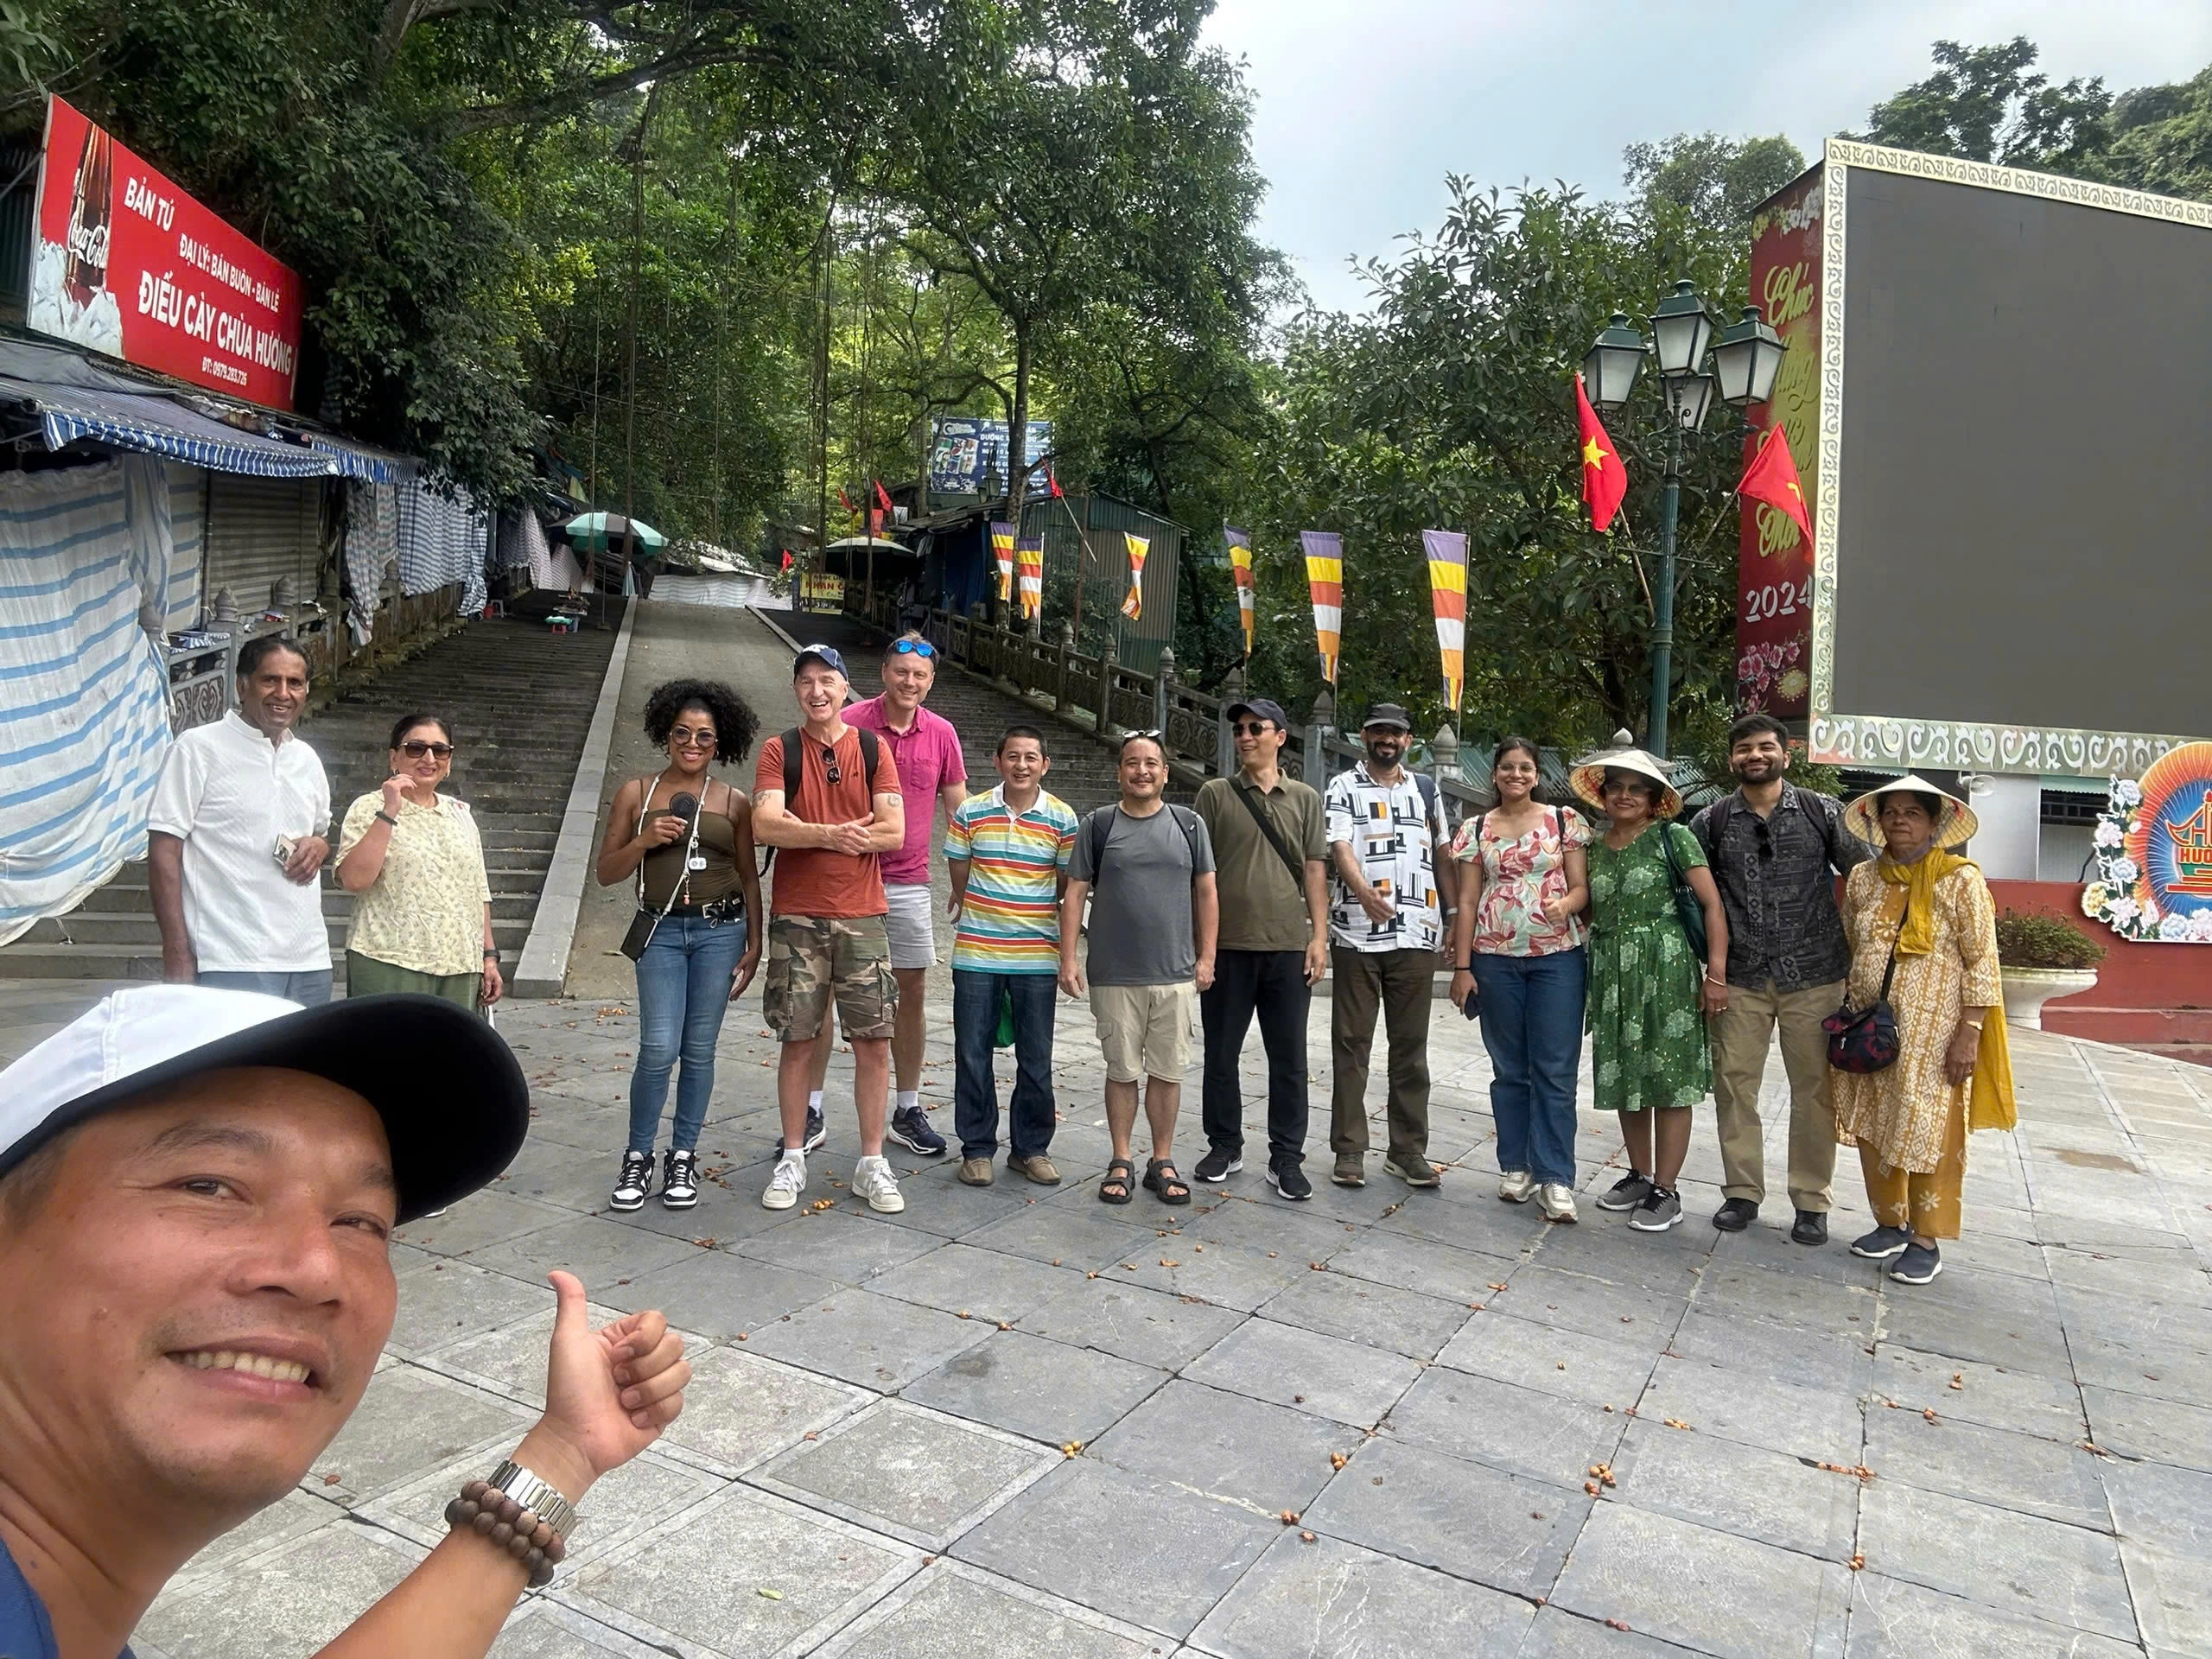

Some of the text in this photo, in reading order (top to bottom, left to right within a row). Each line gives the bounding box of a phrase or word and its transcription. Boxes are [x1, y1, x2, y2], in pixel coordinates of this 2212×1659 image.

[156, 198, 175, 232] TÚ
[179, 232, 198, 267] ĐẠI
[197, 243, 211, 272] LÝ:
[1764, 262, 1815, 327] Chúc
[138, 270, 292, 376] ĐIẾU CÀY CHÙA HƯƠNG
[1745, 574, 1814, 623] 2024
